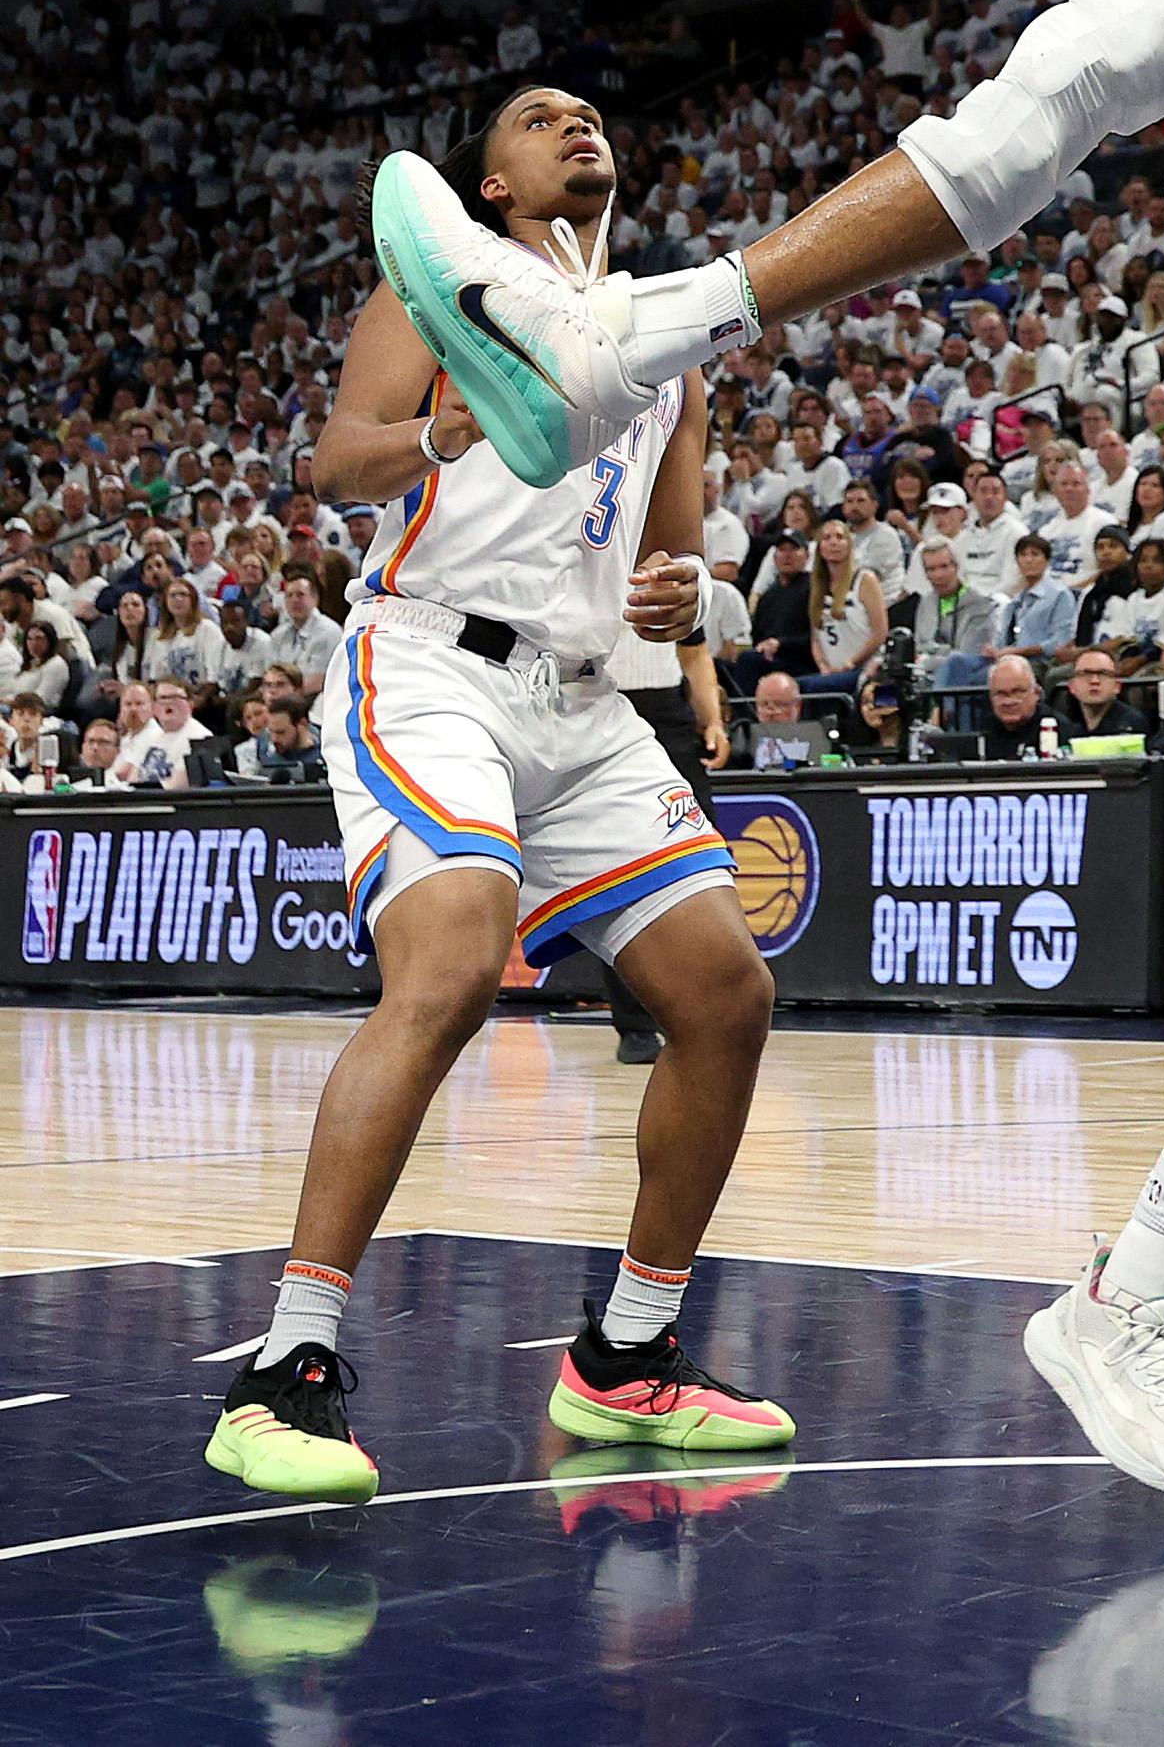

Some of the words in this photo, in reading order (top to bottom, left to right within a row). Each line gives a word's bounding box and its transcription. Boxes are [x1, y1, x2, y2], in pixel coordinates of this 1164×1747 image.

[582, 455, 627, 549] 3
[867, 793, 1088, 887] TOMORROW
[59, 827, 267, 964] PLAYOFFS
[871, 894, 951, 984] 8PM
[956, 901, 1002, 985] ET
